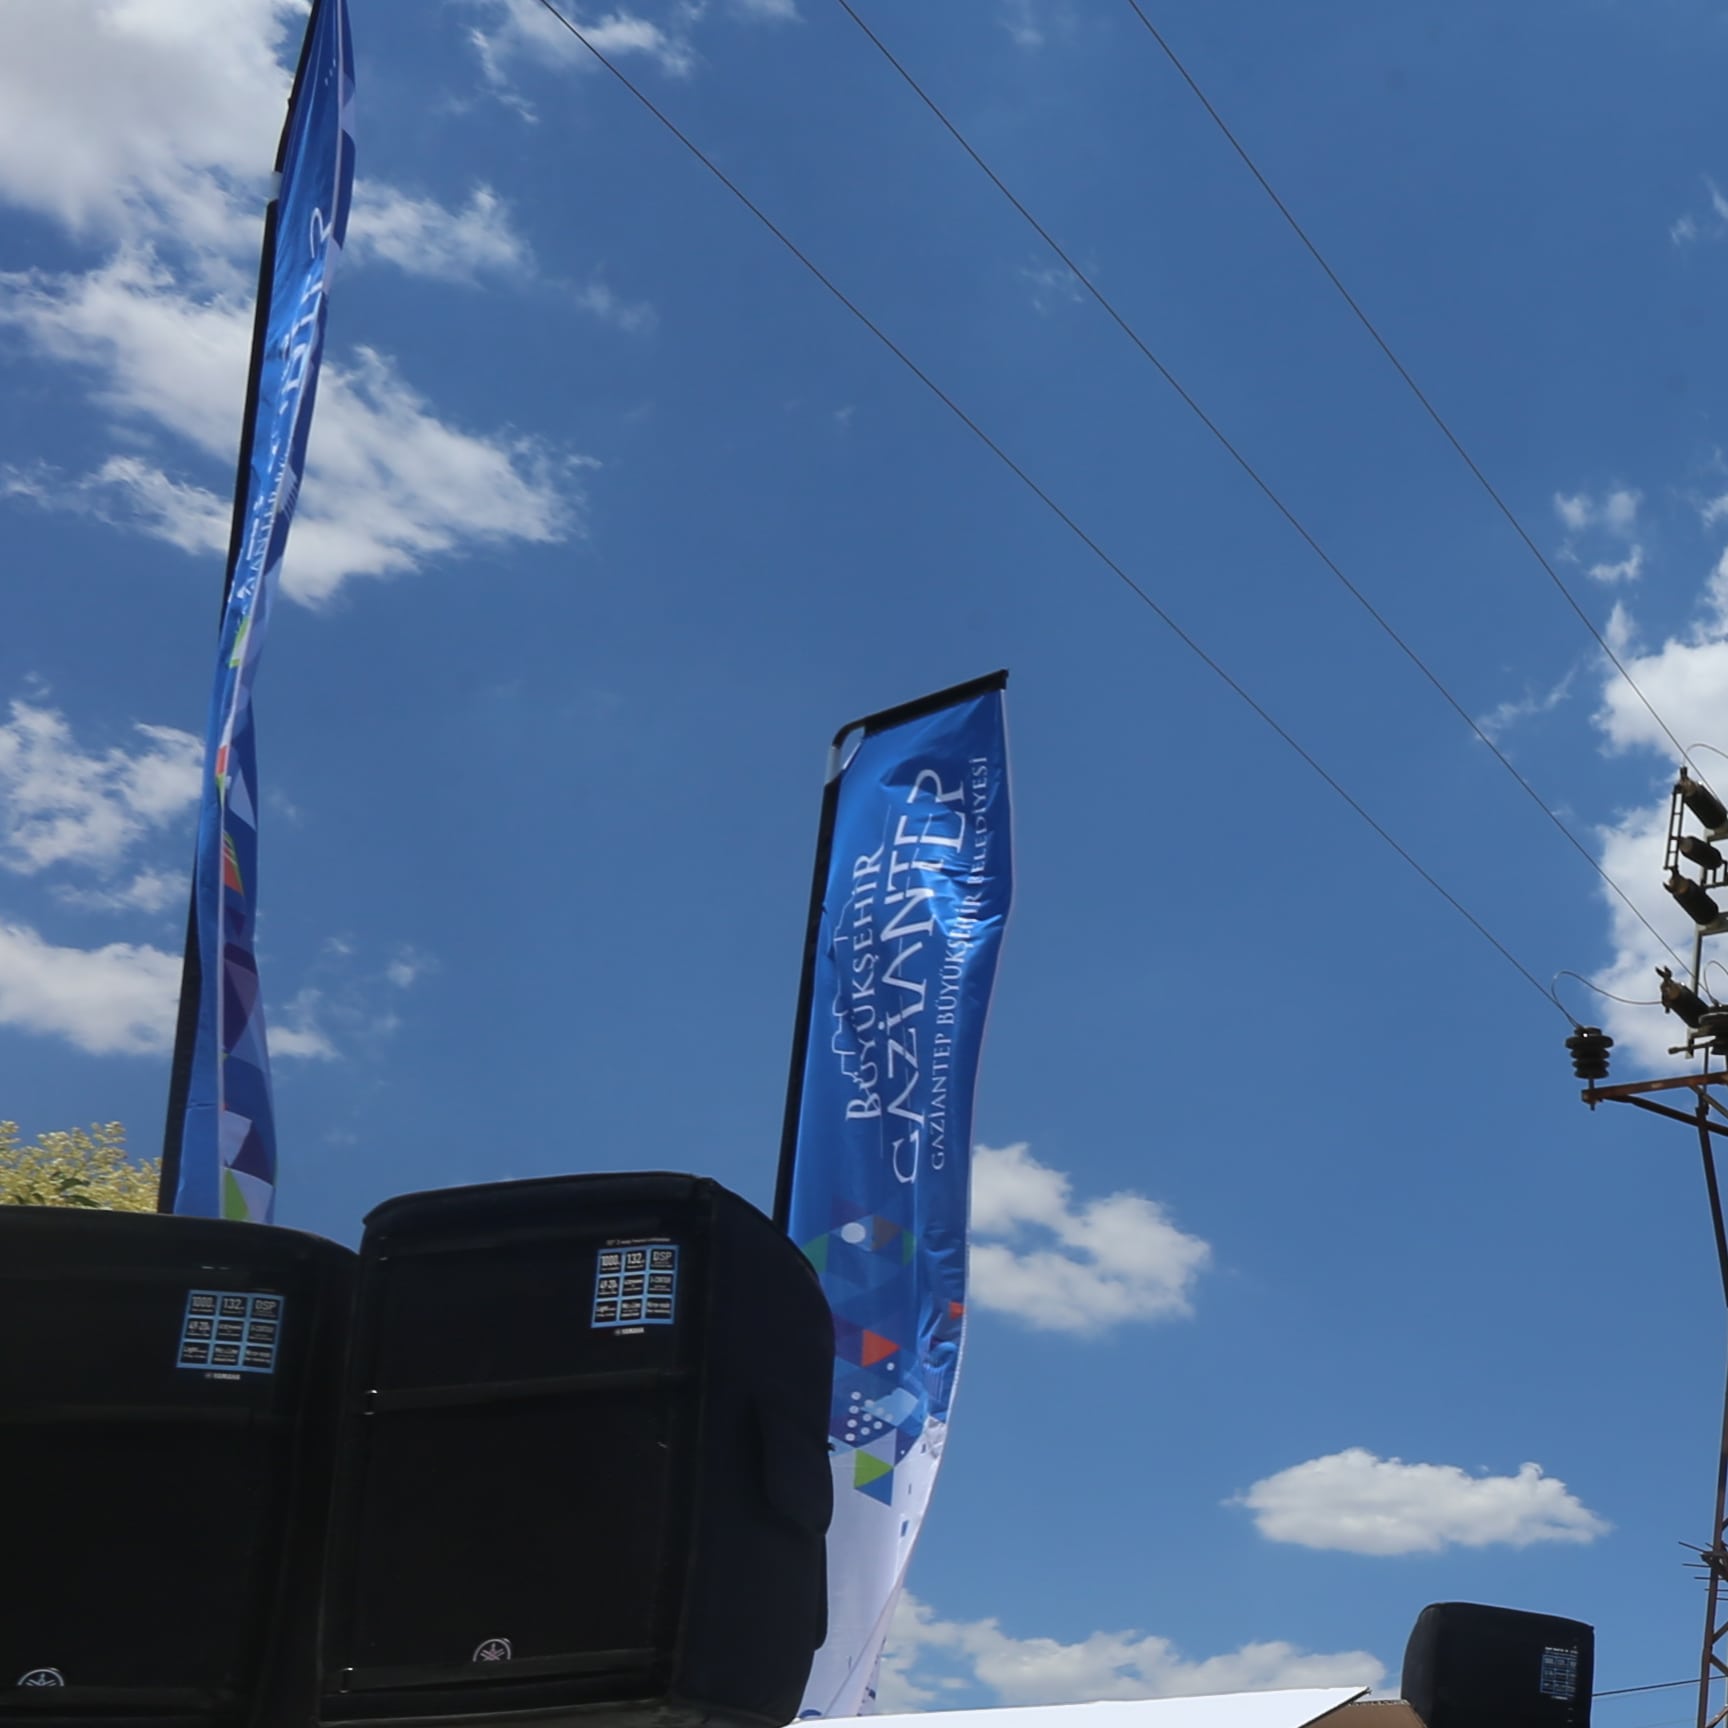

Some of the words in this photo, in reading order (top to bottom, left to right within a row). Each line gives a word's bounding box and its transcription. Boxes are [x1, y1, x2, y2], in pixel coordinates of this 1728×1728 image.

[846, 848, 886, 1121] BÜYÜKŞEHİR
[878, 768, 967, 1185] GAZİANTEP
[931, 1033, 953, 1171] GAZİANTEP
[967, 755, 988, 887] BELEDİYESİ
